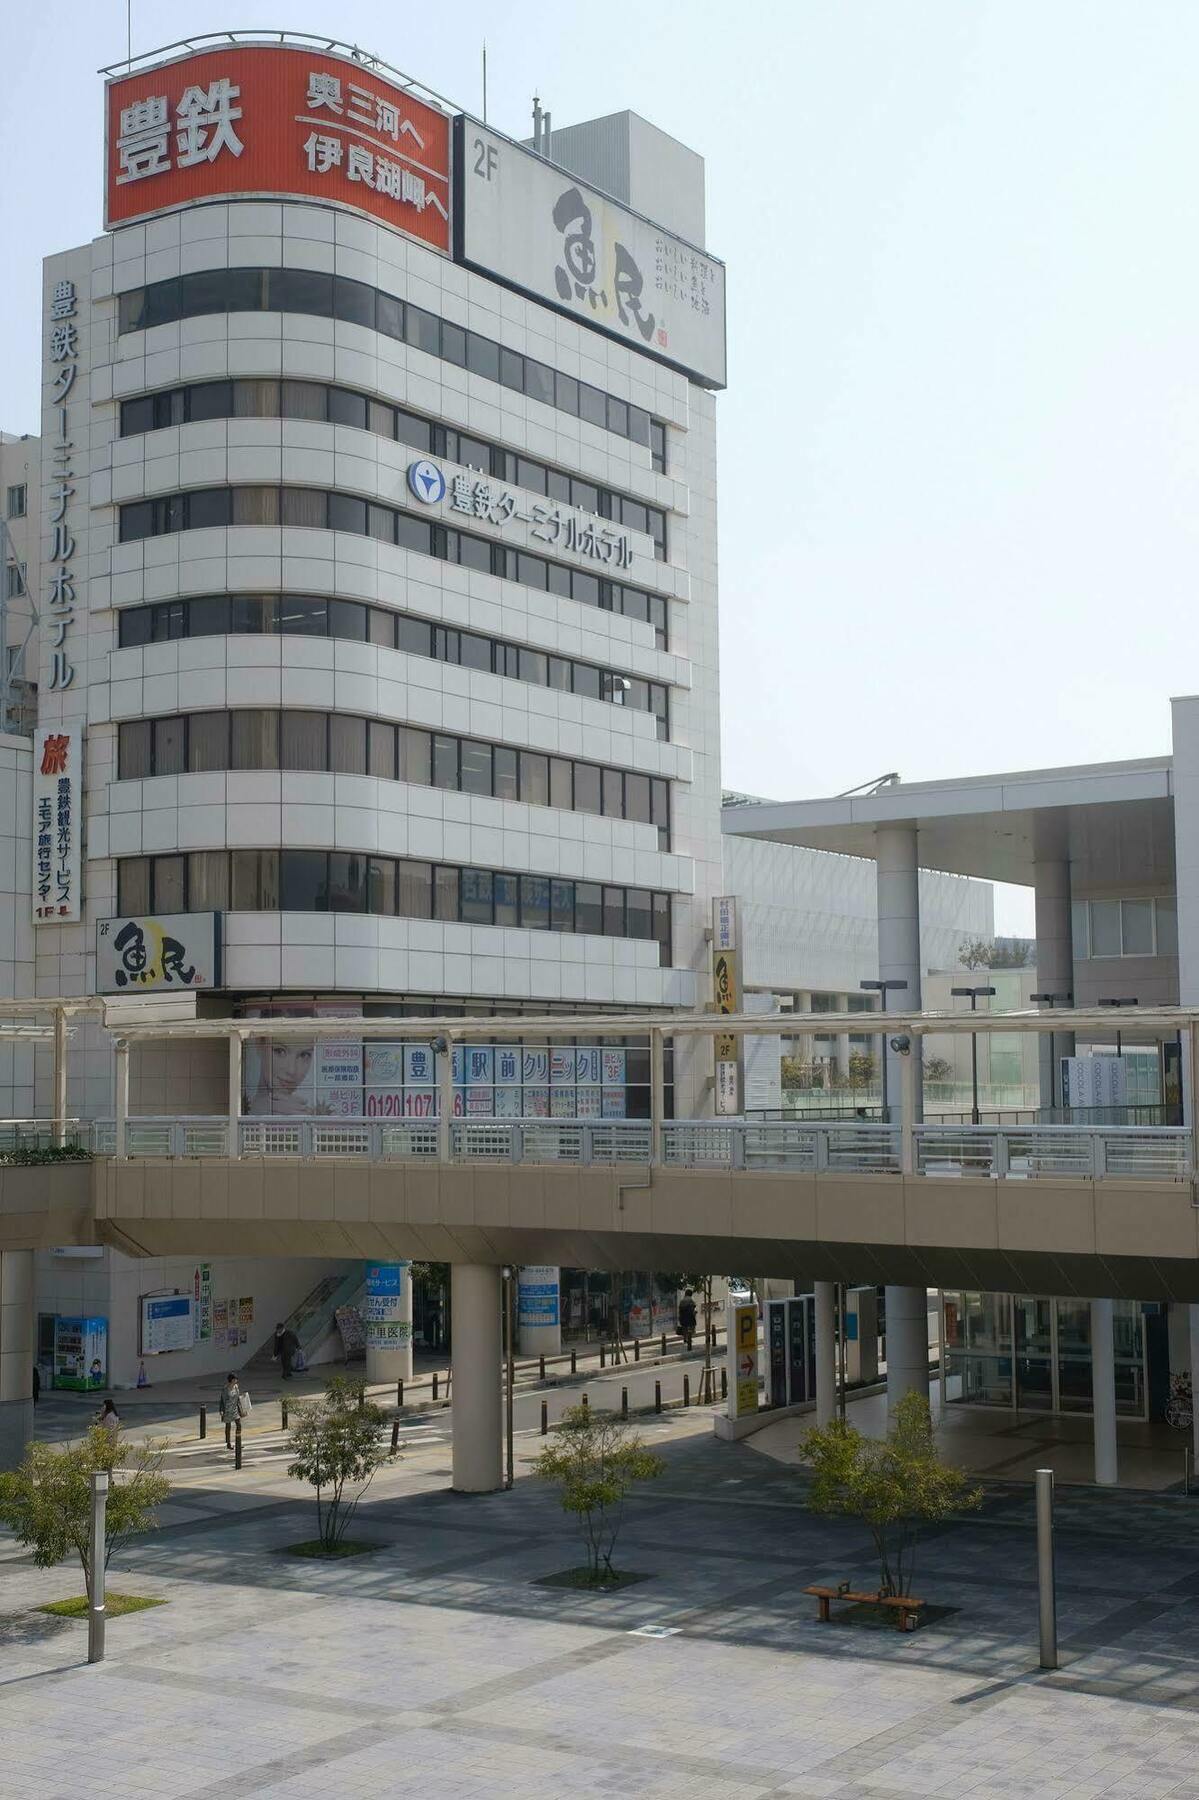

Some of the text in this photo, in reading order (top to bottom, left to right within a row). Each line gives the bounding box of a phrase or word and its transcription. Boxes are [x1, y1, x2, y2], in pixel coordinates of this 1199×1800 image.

[116, 78, 244, 185] 豊鉄
[307, 71, 425, 149] 奥三河へ
[303, 131, 449, 221] 伊良湖岬へ
[473, 138, 498, 182] 2F
[552, 187, 655, 342] 魚民
[49, 280, 78, 689] 豊鉄ターミナルホテル
[451, 475, 633, 569] 豊鉄ターミナルホテル
[40, 733, 71, 775] 旅
[37, 797, 52, 902] エモア旅行センター
[56, 777, 72, 902] 豊鉄観光サービス
[36, 906, 54, 919] 1F
[100, 922, 110, 936] 2F
[114, 921, 196, 987] 魚民
[720, 1045, 730, 1056] 2F
[368, 1095, 400, 1117] 0120
[406, 1094, 432, 1117] 107
[740, 1315, 753, 1344] P
